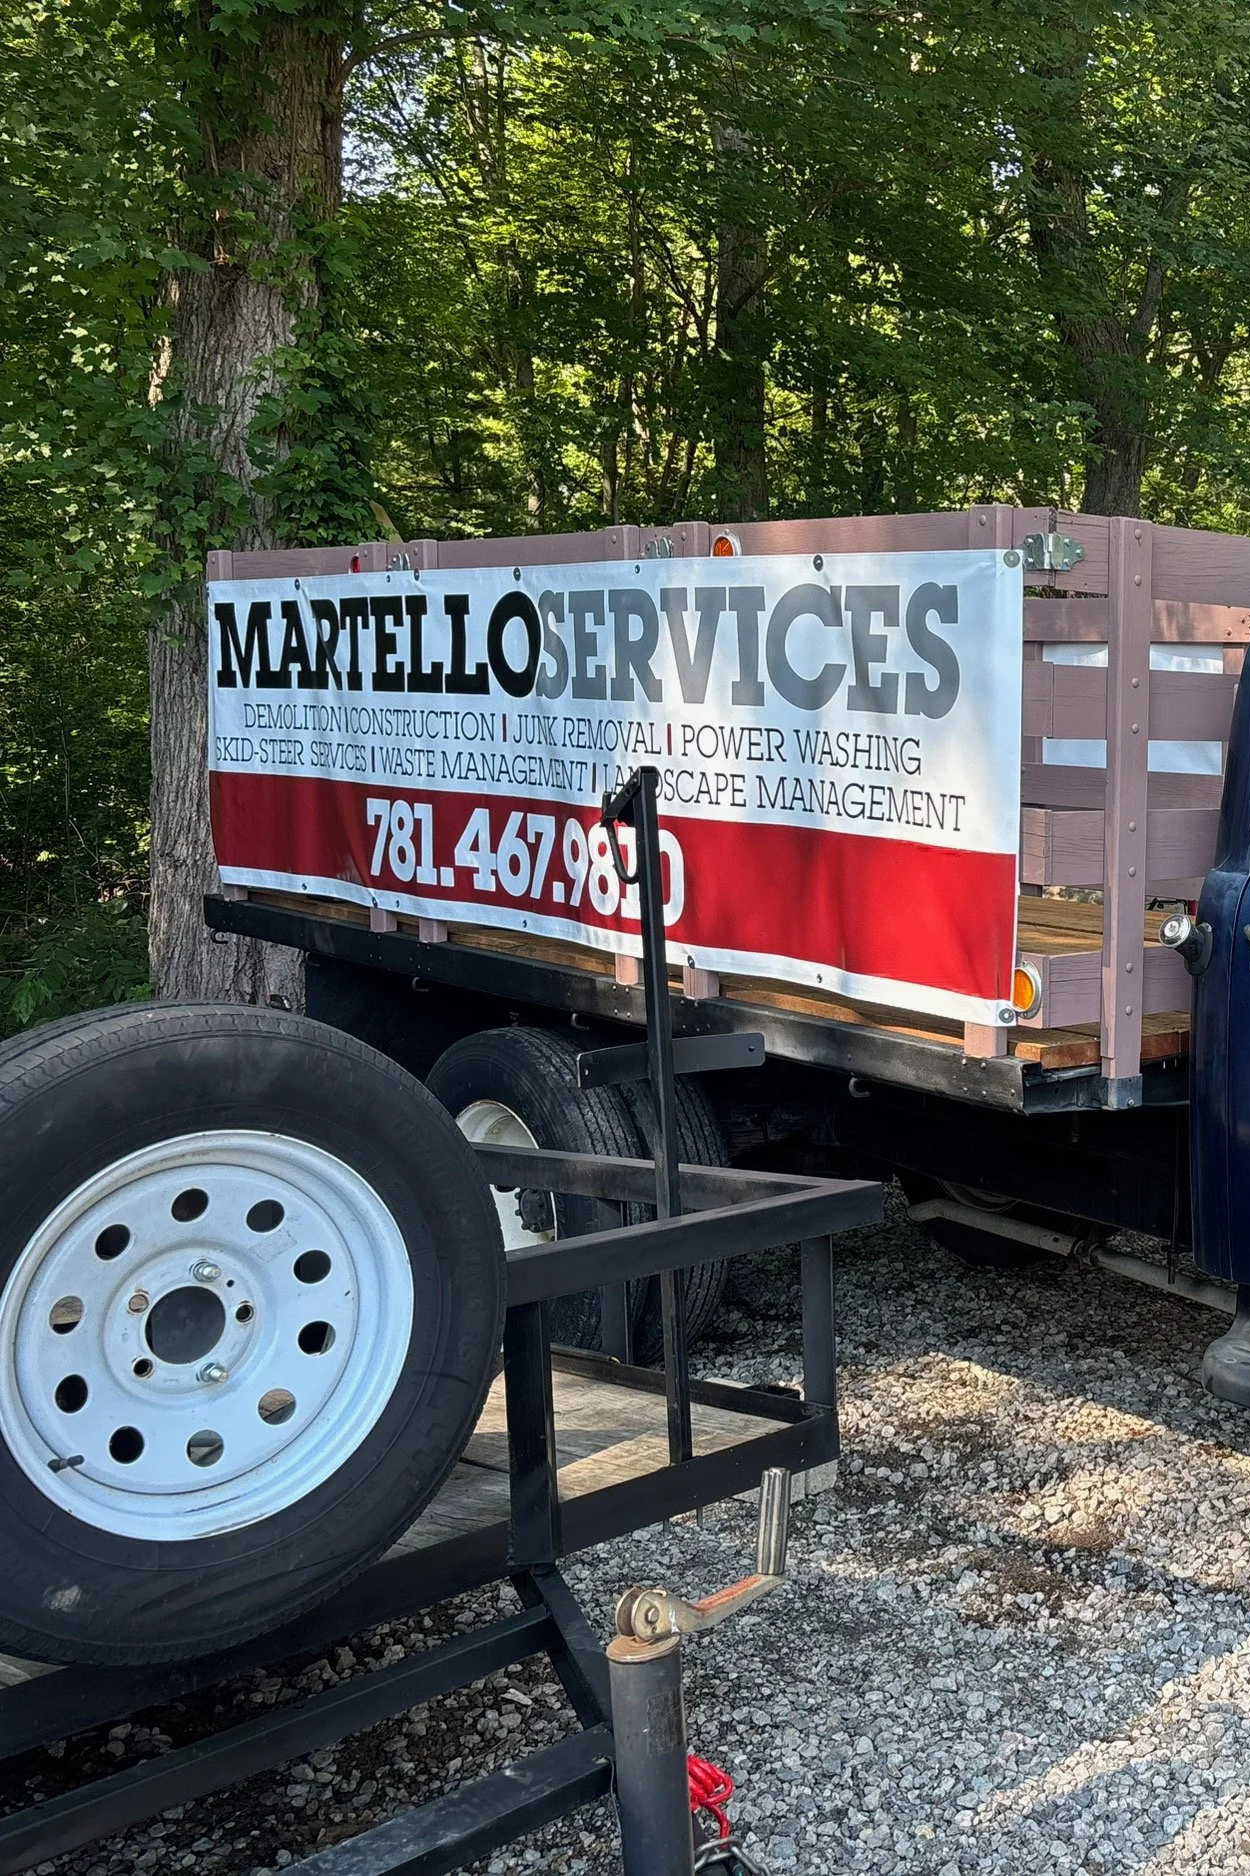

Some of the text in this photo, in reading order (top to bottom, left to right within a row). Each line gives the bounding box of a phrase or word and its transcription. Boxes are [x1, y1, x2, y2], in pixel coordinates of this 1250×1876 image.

[216, 736, 965, 831] SKID-STEER SERVICES WASTE MANAGEMENT LASCAPE MANAGEMENT
[349, 706, 495, 741] CONSTRUCTION
[513, 714, 558, 746] JUNK
[561, 717, 662, 755] REMOVAL
[681, 724, 787, 763] POWER
[793, 729, 922, 775] WASHING
[366, 797, 684, 926] 781.467.9810
